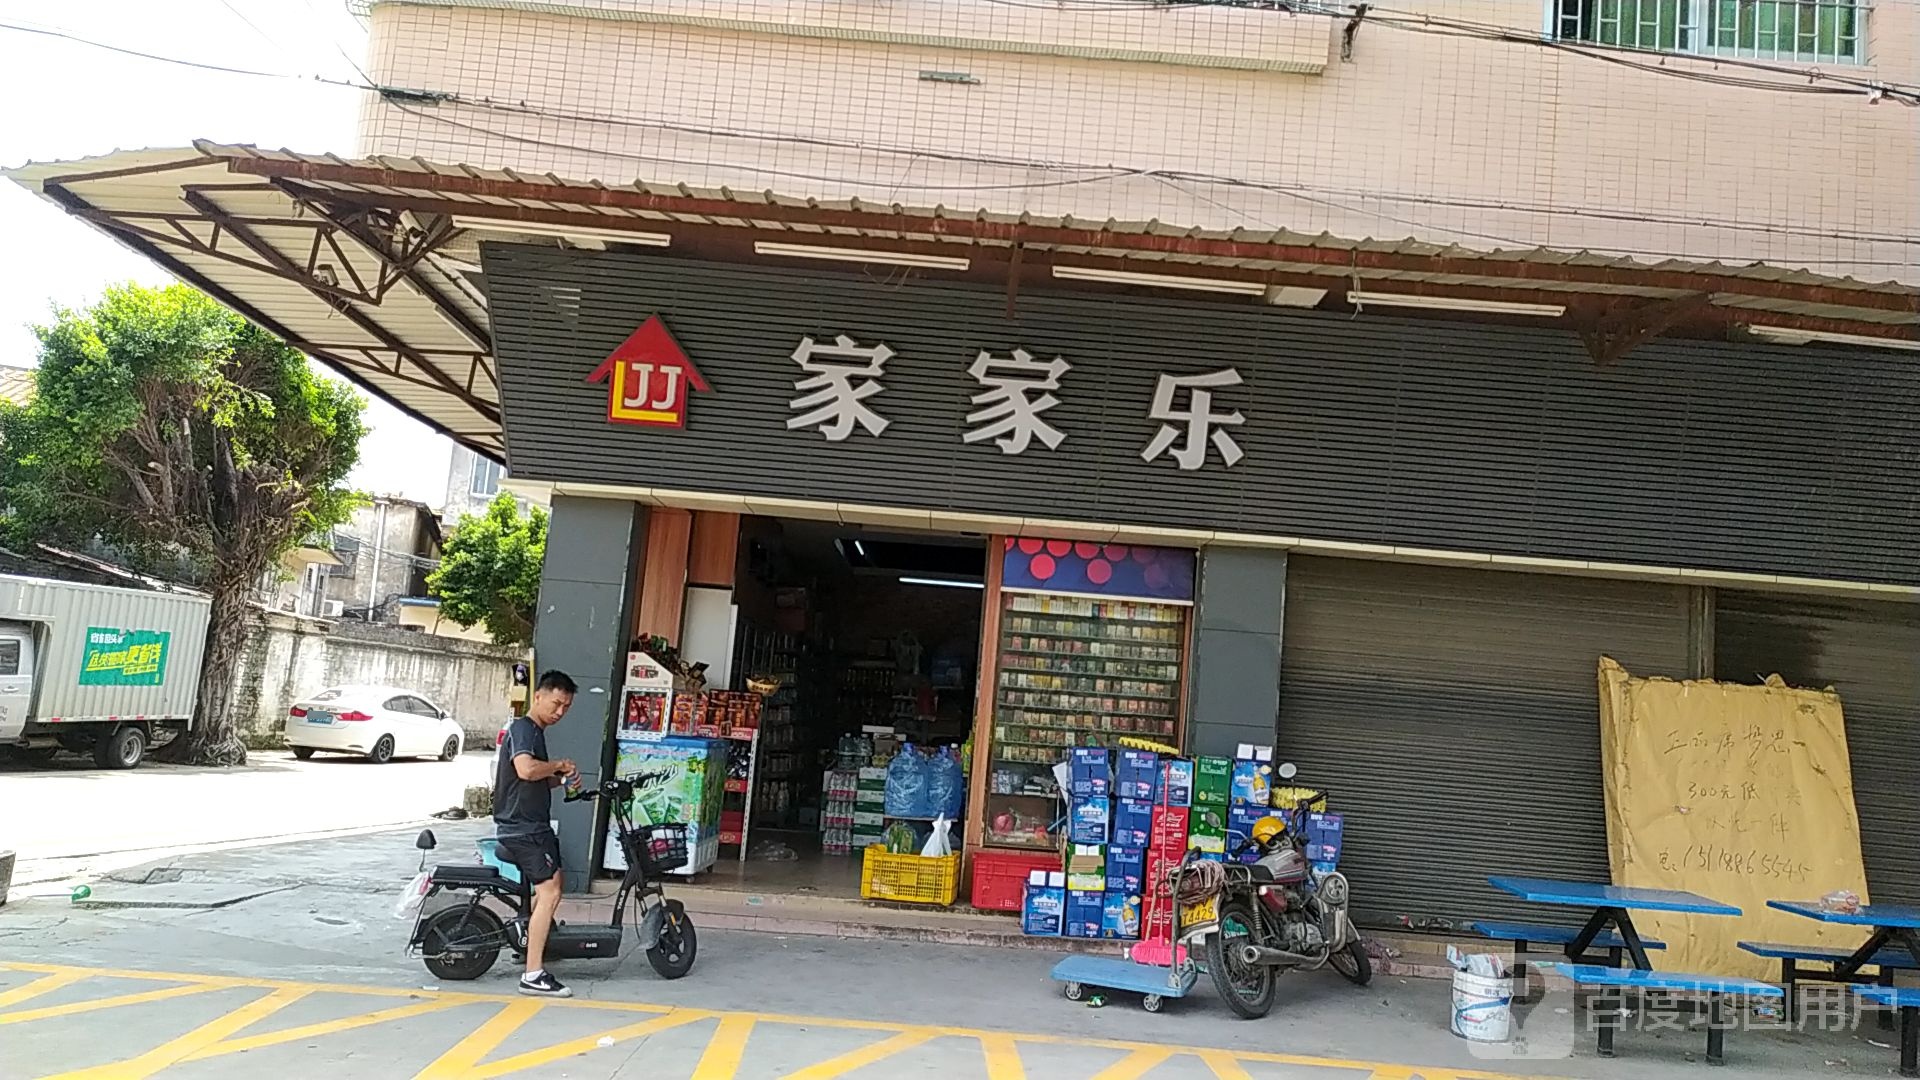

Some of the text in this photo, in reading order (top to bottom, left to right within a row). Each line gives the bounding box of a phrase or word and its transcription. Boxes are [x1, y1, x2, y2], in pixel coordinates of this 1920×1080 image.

[786, 334, 1247, 470] 家家乐
[1182, 906, 1215, 926] T4429
